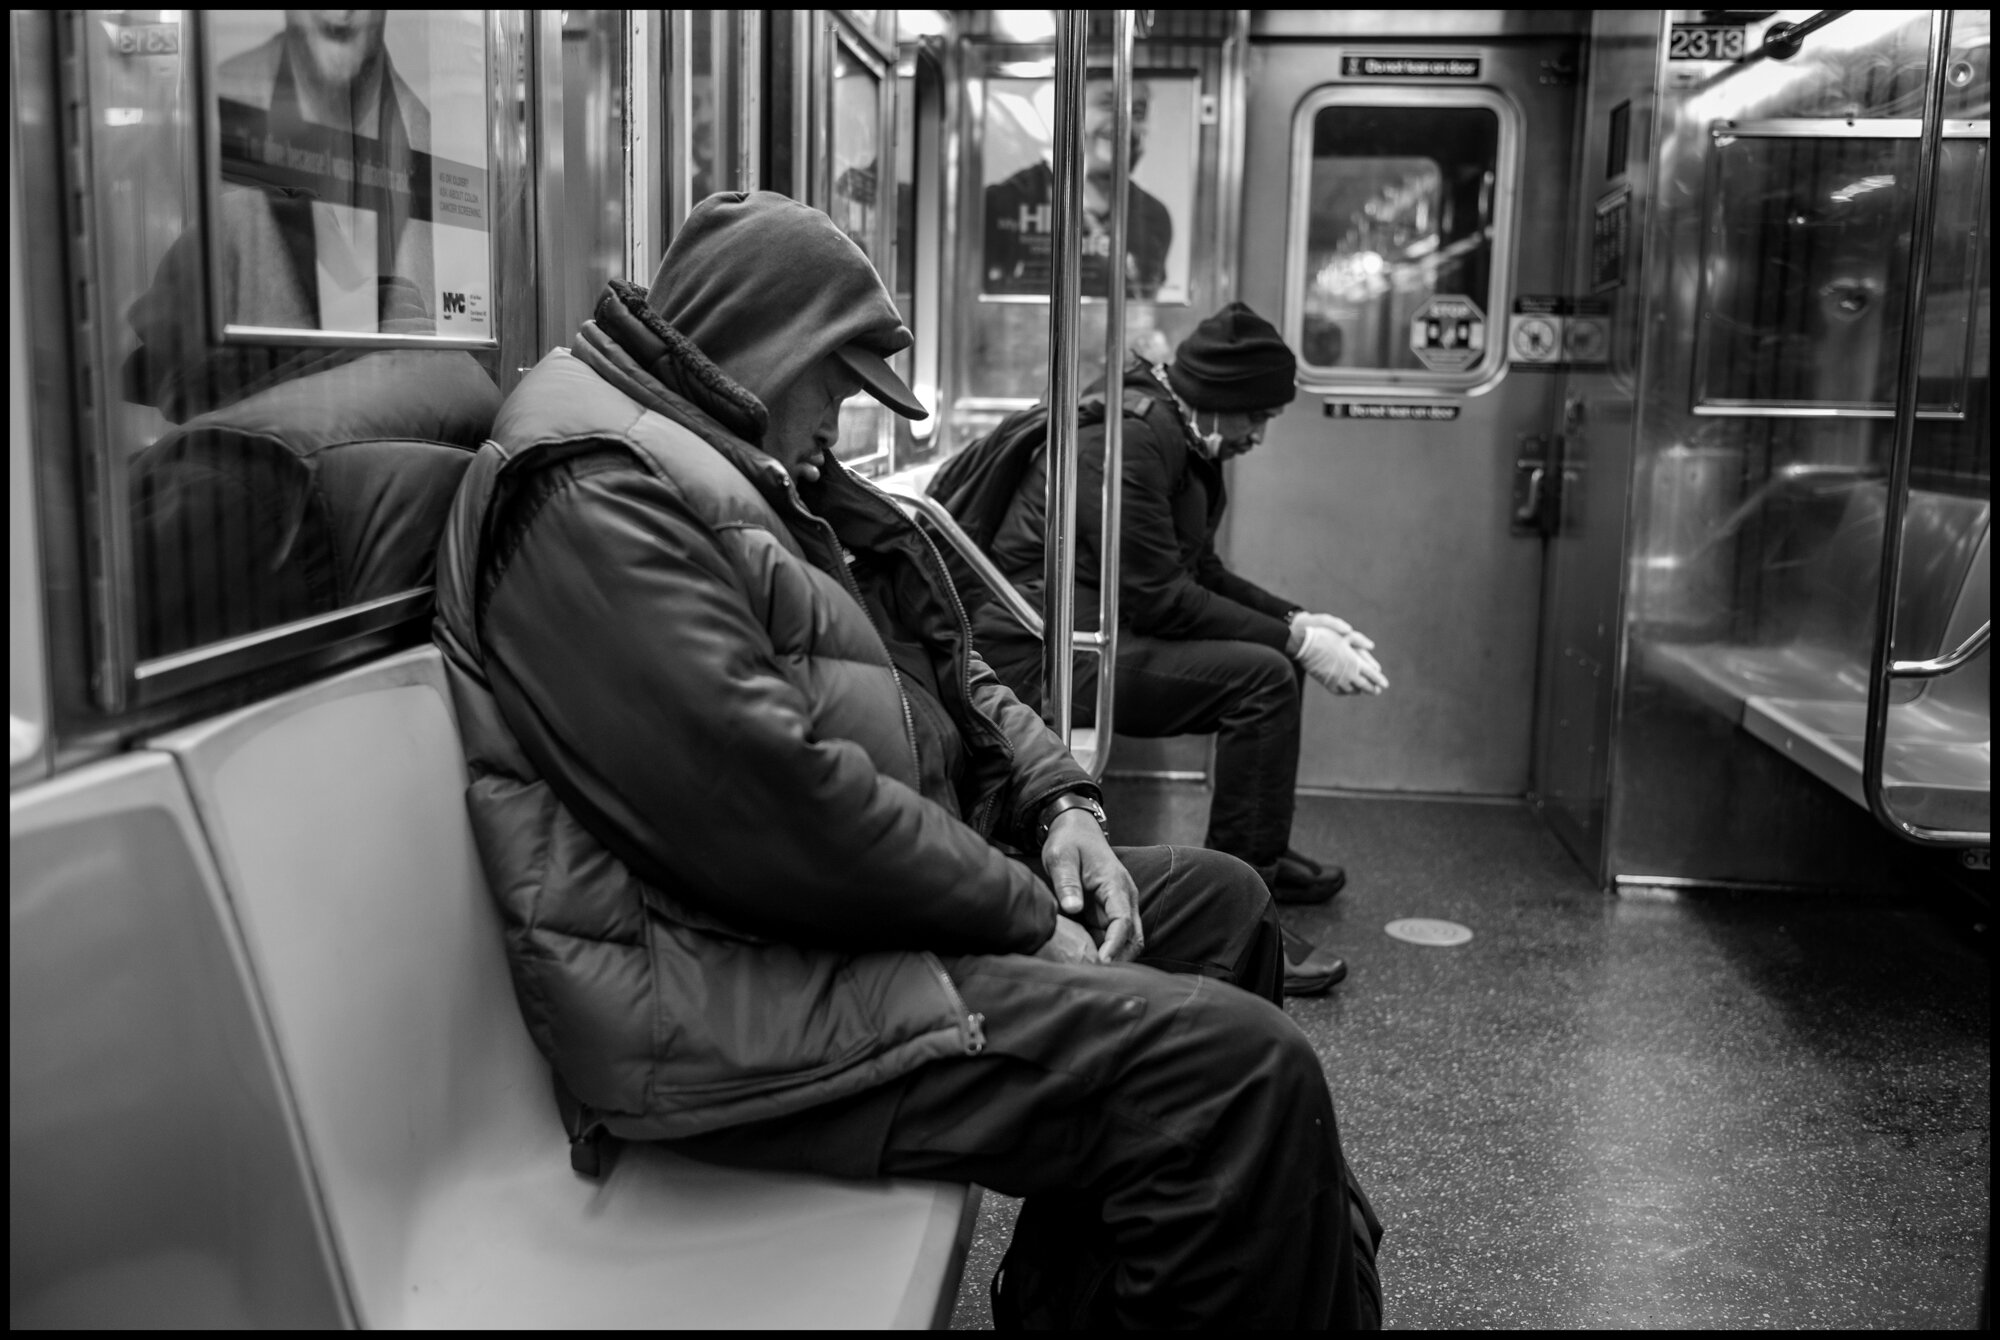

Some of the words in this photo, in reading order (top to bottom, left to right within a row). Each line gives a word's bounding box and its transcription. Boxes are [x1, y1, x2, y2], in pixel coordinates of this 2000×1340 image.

[1671, 31, 1743, 58] 2313
[1364, 59, 1384, 75] Do
[1386, 60, 1403, 75] not
[1406, 60, 1429, 75] lean
[1430, 63, 1446, 75] on
[1446, 60, 1476, 76] door
[443, 291, 465, 313] NYC
[1430, 302, 1469, 318] STOP
[1349, 405, 1369, 418] Do
[1369, 406, 1386, 418] not
[1387, 406, 1410, 419] lean
[1411, 408, 1426, 419] on
[1427, 406, 1455, 420] door
